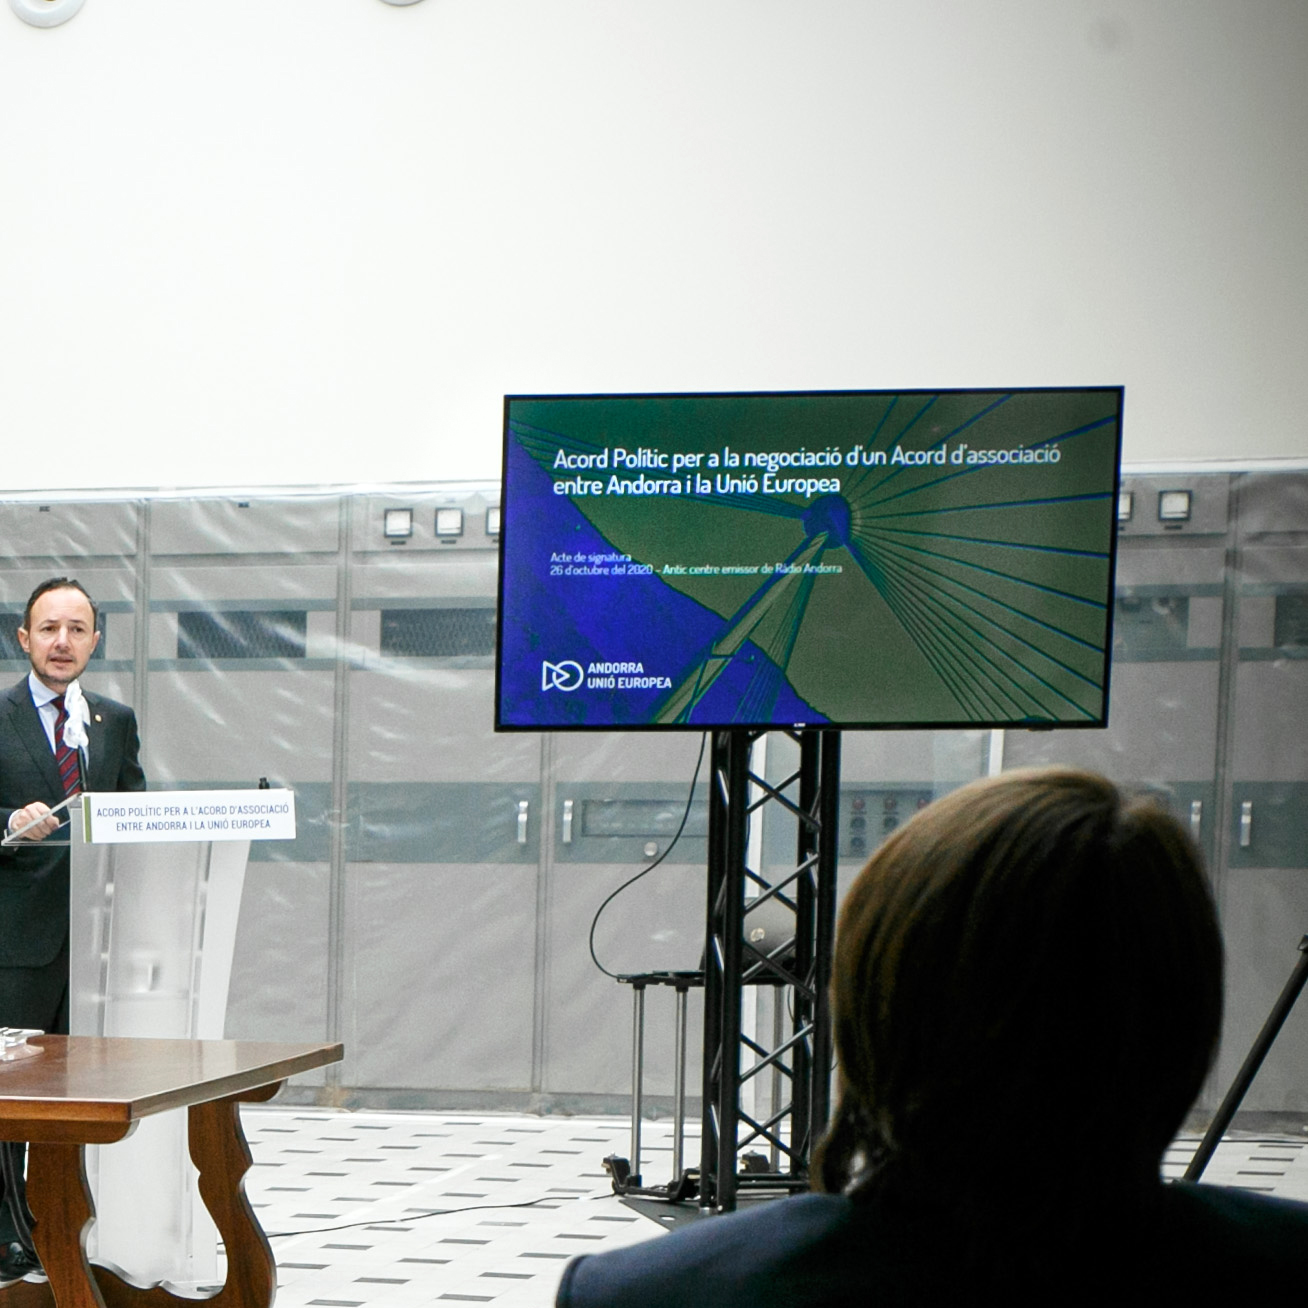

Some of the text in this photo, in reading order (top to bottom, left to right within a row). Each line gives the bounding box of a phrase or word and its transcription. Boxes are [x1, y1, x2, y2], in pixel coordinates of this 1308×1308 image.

[553, 444, 1061, 473] Acord Polític per a la negociació d'un Acord d'associació
[553, 472, 841, 498] entre Andorra i la Unió Europea
[550, 551, 632, 565] Acte de signatura
[550, 564, 564, 575] 26
[565, 564, 610, 576] d'octubre
[610, 564, 626, 575] del
[627, 563, 653, 575] 2020
[663, 564, 687, 574] Antic
[688, 563, 720, 574] centre
[721, 564, 759, 574] emissor
[760, 562, 774, 574] de
[803, 562, 843, 574] Andorra
[587, 662, 644, 674] ANDORRA
[587, 675, 672, 689] UNIÓ EUROPEA
[97, 802, 289, 817] ACORD POLÍTIC PER A L'ACORD D'ASSOCIACIÓ
[116, 821, 144, 832] ENTRE
[146, 821, 188, 831] ANDORRA
[194, 820, 205, 830] LA
[207, 818, 229, 830] UNIÓ
[231, 819, 271, 830] EUROPEA
